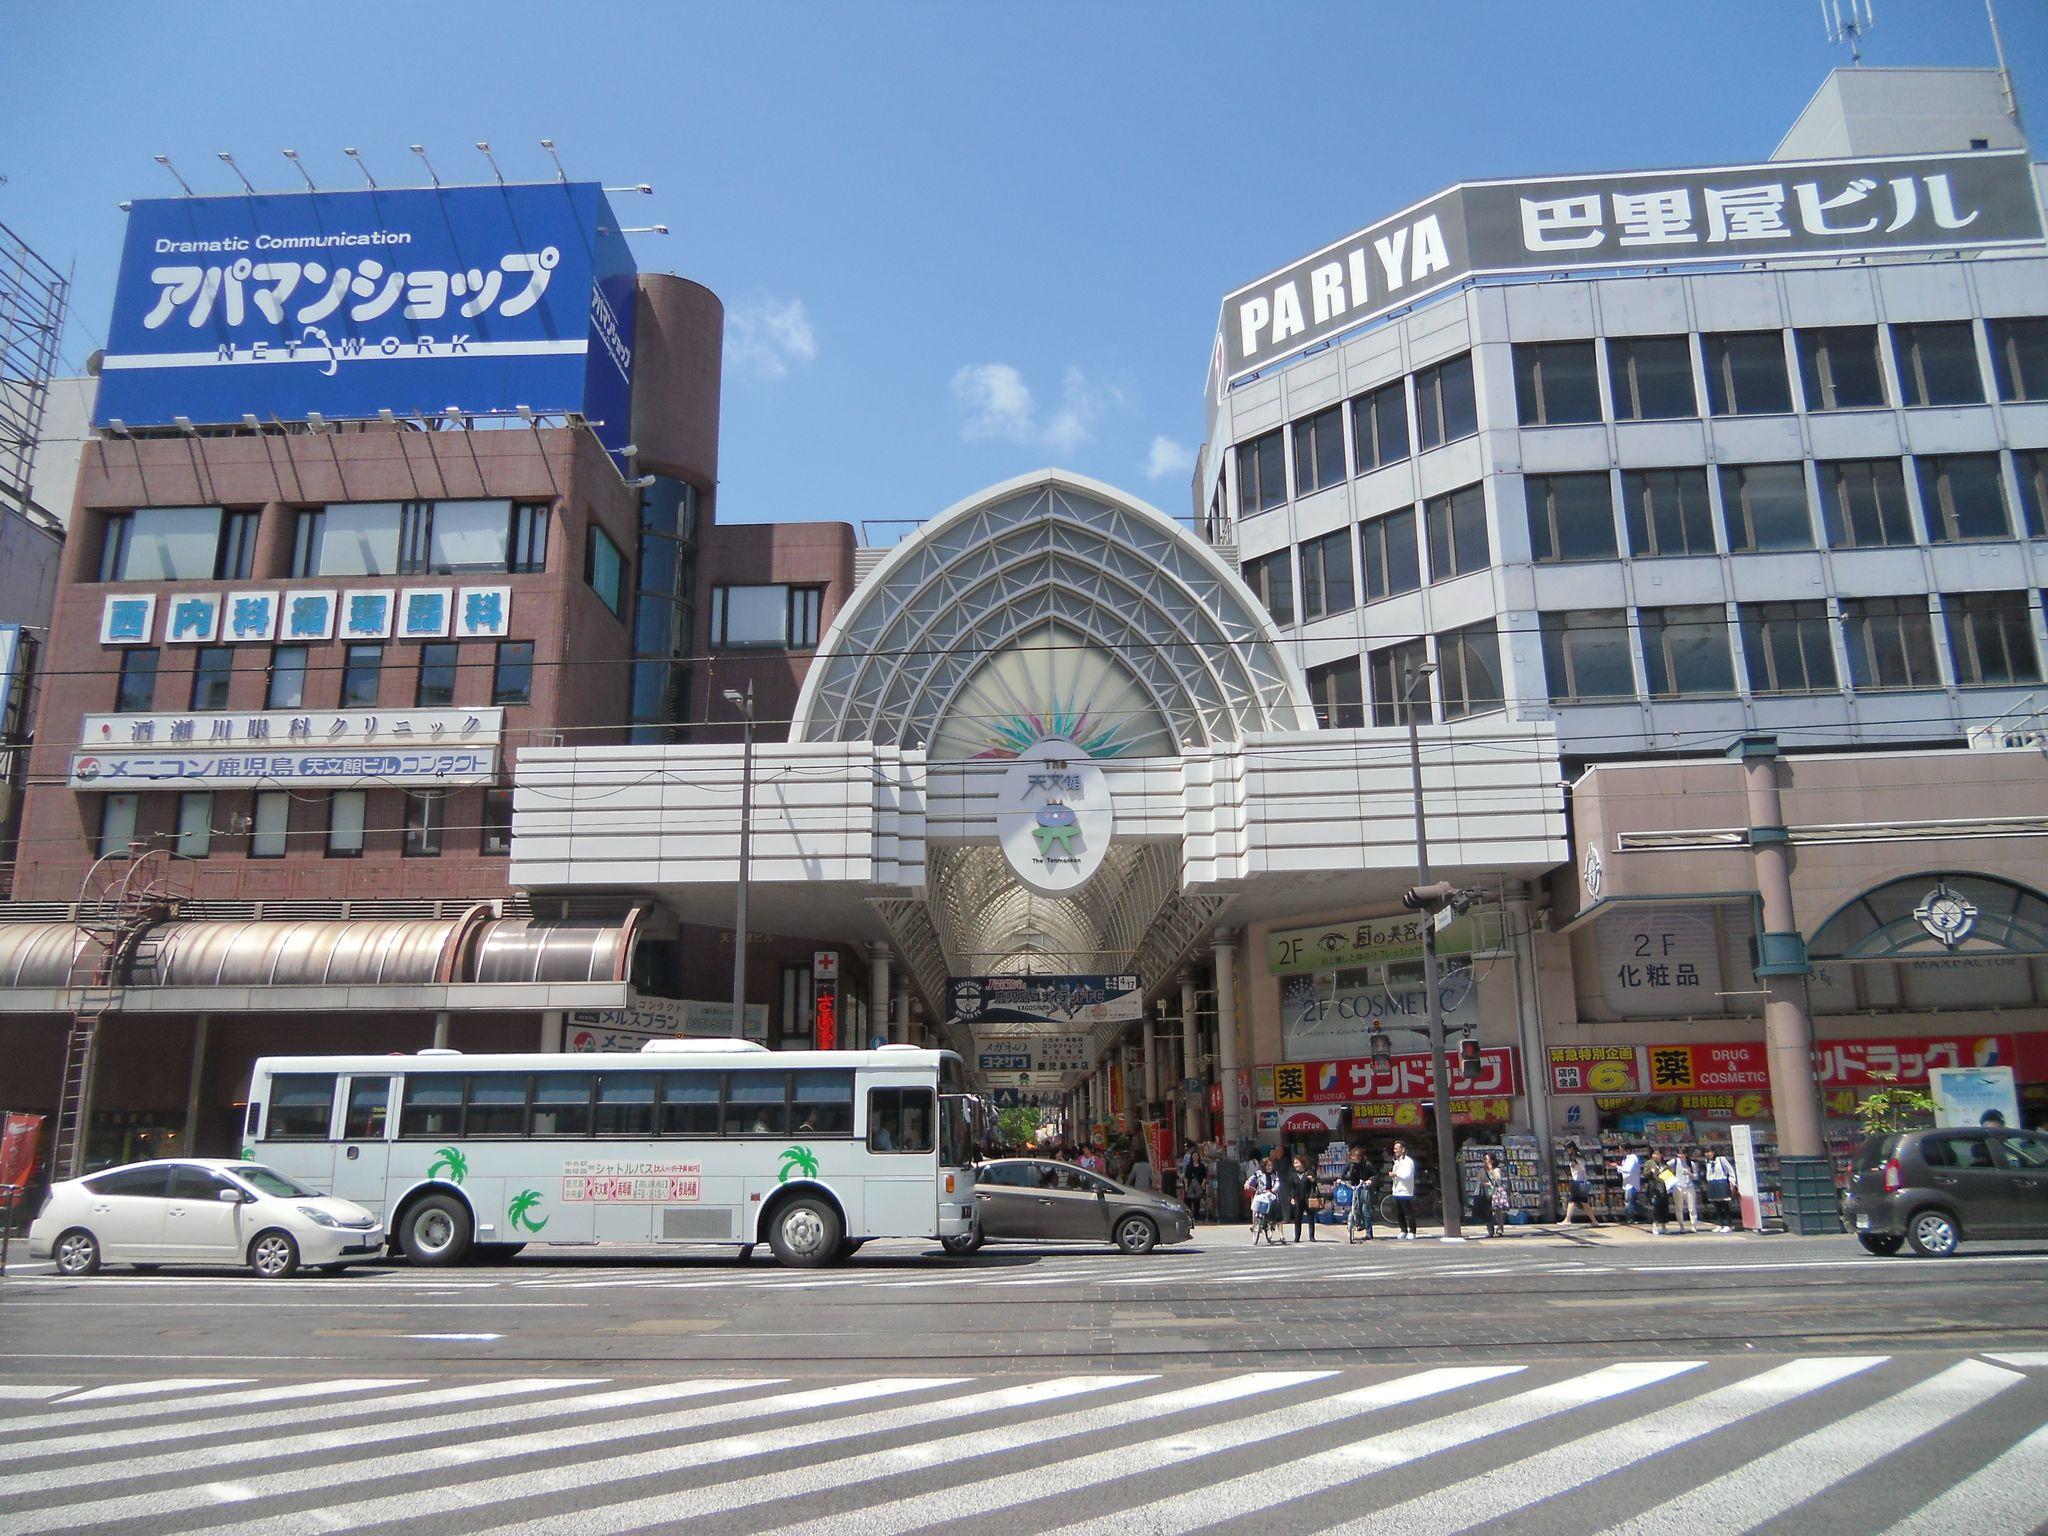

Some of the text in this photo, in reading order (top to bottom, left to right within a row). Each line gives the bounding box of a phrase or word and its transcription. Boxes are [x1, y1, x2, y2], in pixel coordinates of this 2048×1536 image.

[1520, 174, 1980, 252] 巴里屋ビル
[155, 230, 412, 254] Dramatic Communication
[143, 246, 560, 330] アパマンショップ
[1240, 214, 1452, 358] PARIYA
[109, 591, 502, 638] 西内科循環器科
[109, 755, 488, 778] メニコン鹿児島 天文館ビル コンタクト
[1020, 772, 1081, 801] 天文館
[1278, 938, 1304, 965] 2F
[1633, 933, 1675, 957] 2F
[1127, 981, 1135, 989] 17
[1617, 963, 1700, 988] 化粧品
[638, 1000, 682, 1013] コンタクト
[1302, 988, 1457, 1022] 2F COSMETC
[601, 1011, 680, 1031] メルスプラン
[1550, 1046, 1633, 1062] 緊急特別企画
[1711, 1049, 1749, 1062] DRUG
[1653, 1050, 1691, 1086] 薬
[1700, 1071, 1767, 1085] COSMETIC
[1728, 1061, 1737, 1072] &
[1278, 1066, 1304, 1099] 薬
[1287, 1120, 1301, 1131] Tax
[1302, 1119, 1320, 1130] Free
